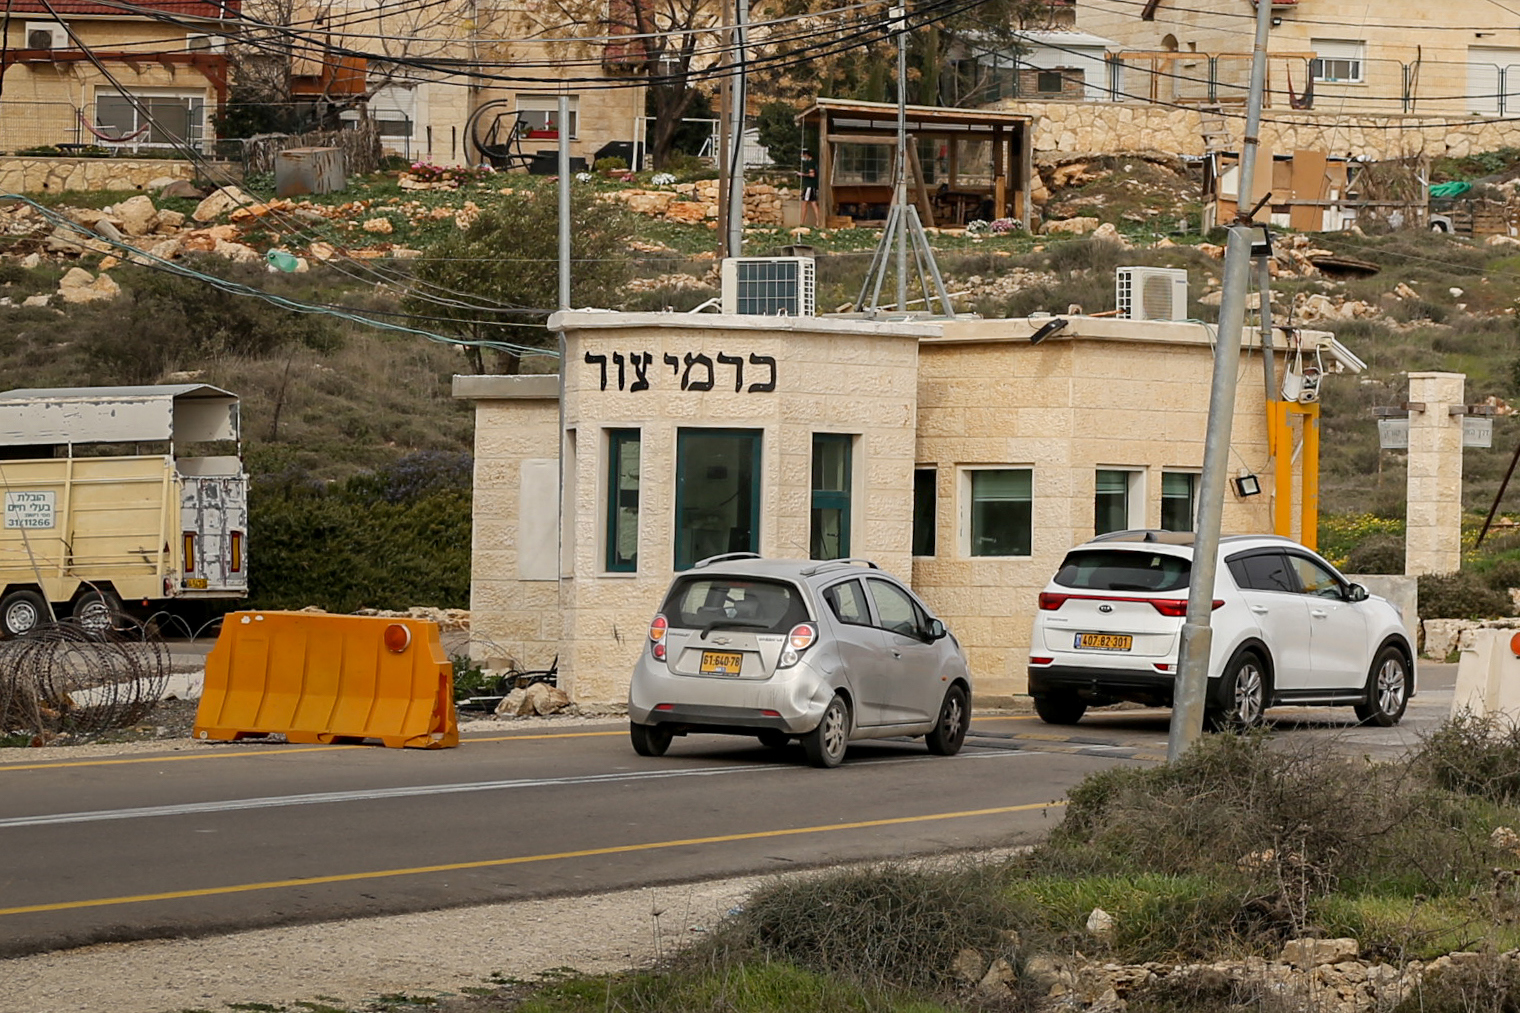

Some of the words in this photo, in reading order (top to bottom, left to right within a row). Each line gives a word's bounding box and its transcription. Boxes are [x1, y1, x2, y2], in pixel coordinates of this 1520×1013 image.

[584, 351, 653, 392] צור
[664, 351, 777, 393] כרמי
[17, 492, 46, 502] הובלת
[7, 504, 26, 512] חיים
[29, 502, 51, 512] בעלי
